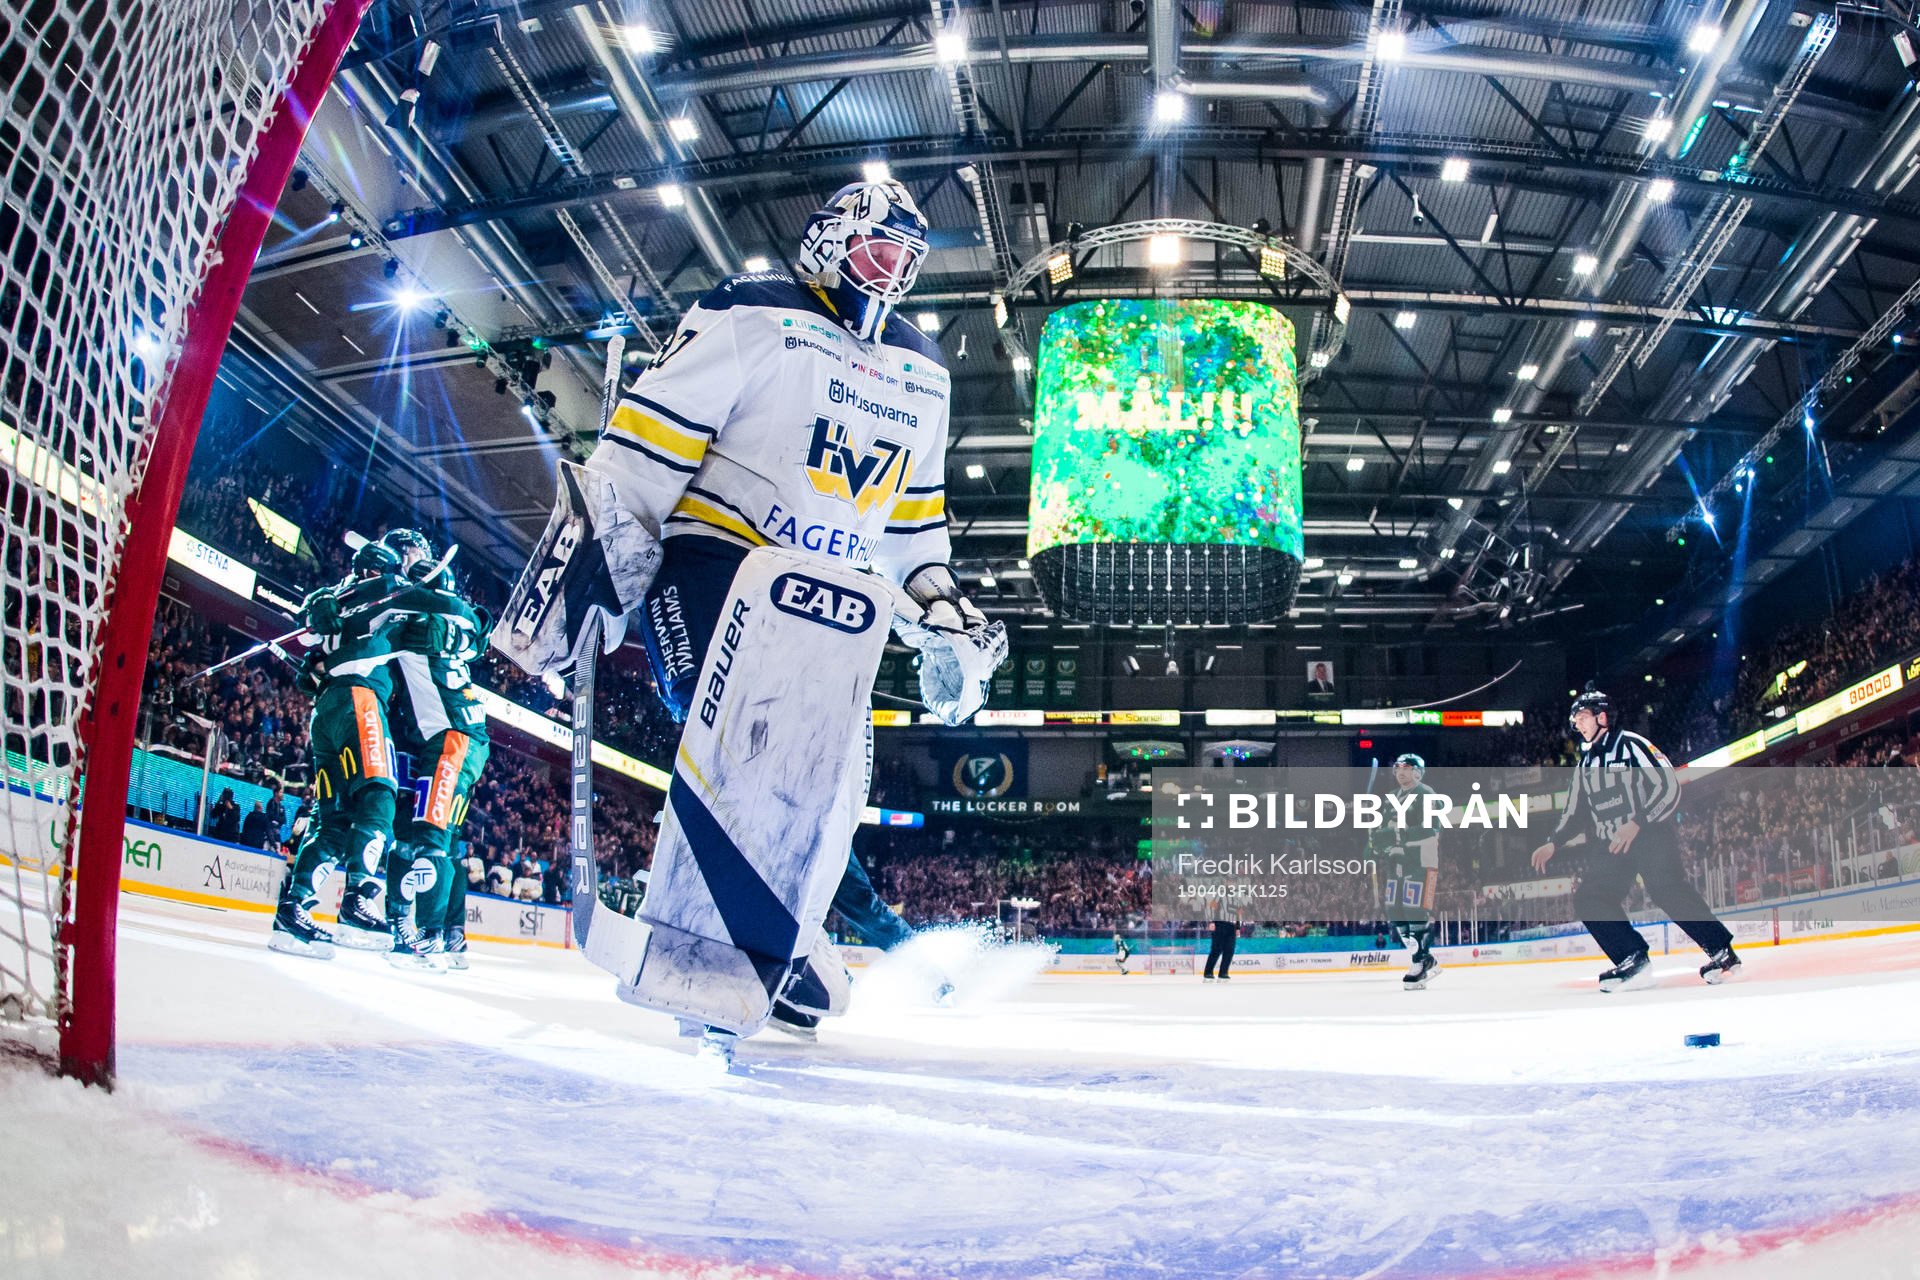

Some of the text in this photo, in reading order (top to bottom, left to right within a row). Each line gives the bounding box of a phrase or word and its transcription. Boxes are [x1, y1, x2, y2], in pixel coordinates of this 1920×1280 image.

[798, 338, 842, 363] Husqvarna
[857, 365, 899, 387] INERSORT
[845, 386, 918, 429] Husqvarna
[806, 416, 913, 500] HV71
[195, 543, 229, 571] STENA
[763, 503, 879, 563] FAGERHU
[515, 523, 581, 641] EAB
[778, 578, 864, 631] EAB
[650, 597, 678, 682] SHERWIN
[664, 585, 695, 674] WILLIAMS
[932, 801, 1080, 813] THE LOCKER ROOM
[1350, 952, 1391, 965] Hyrbilar
